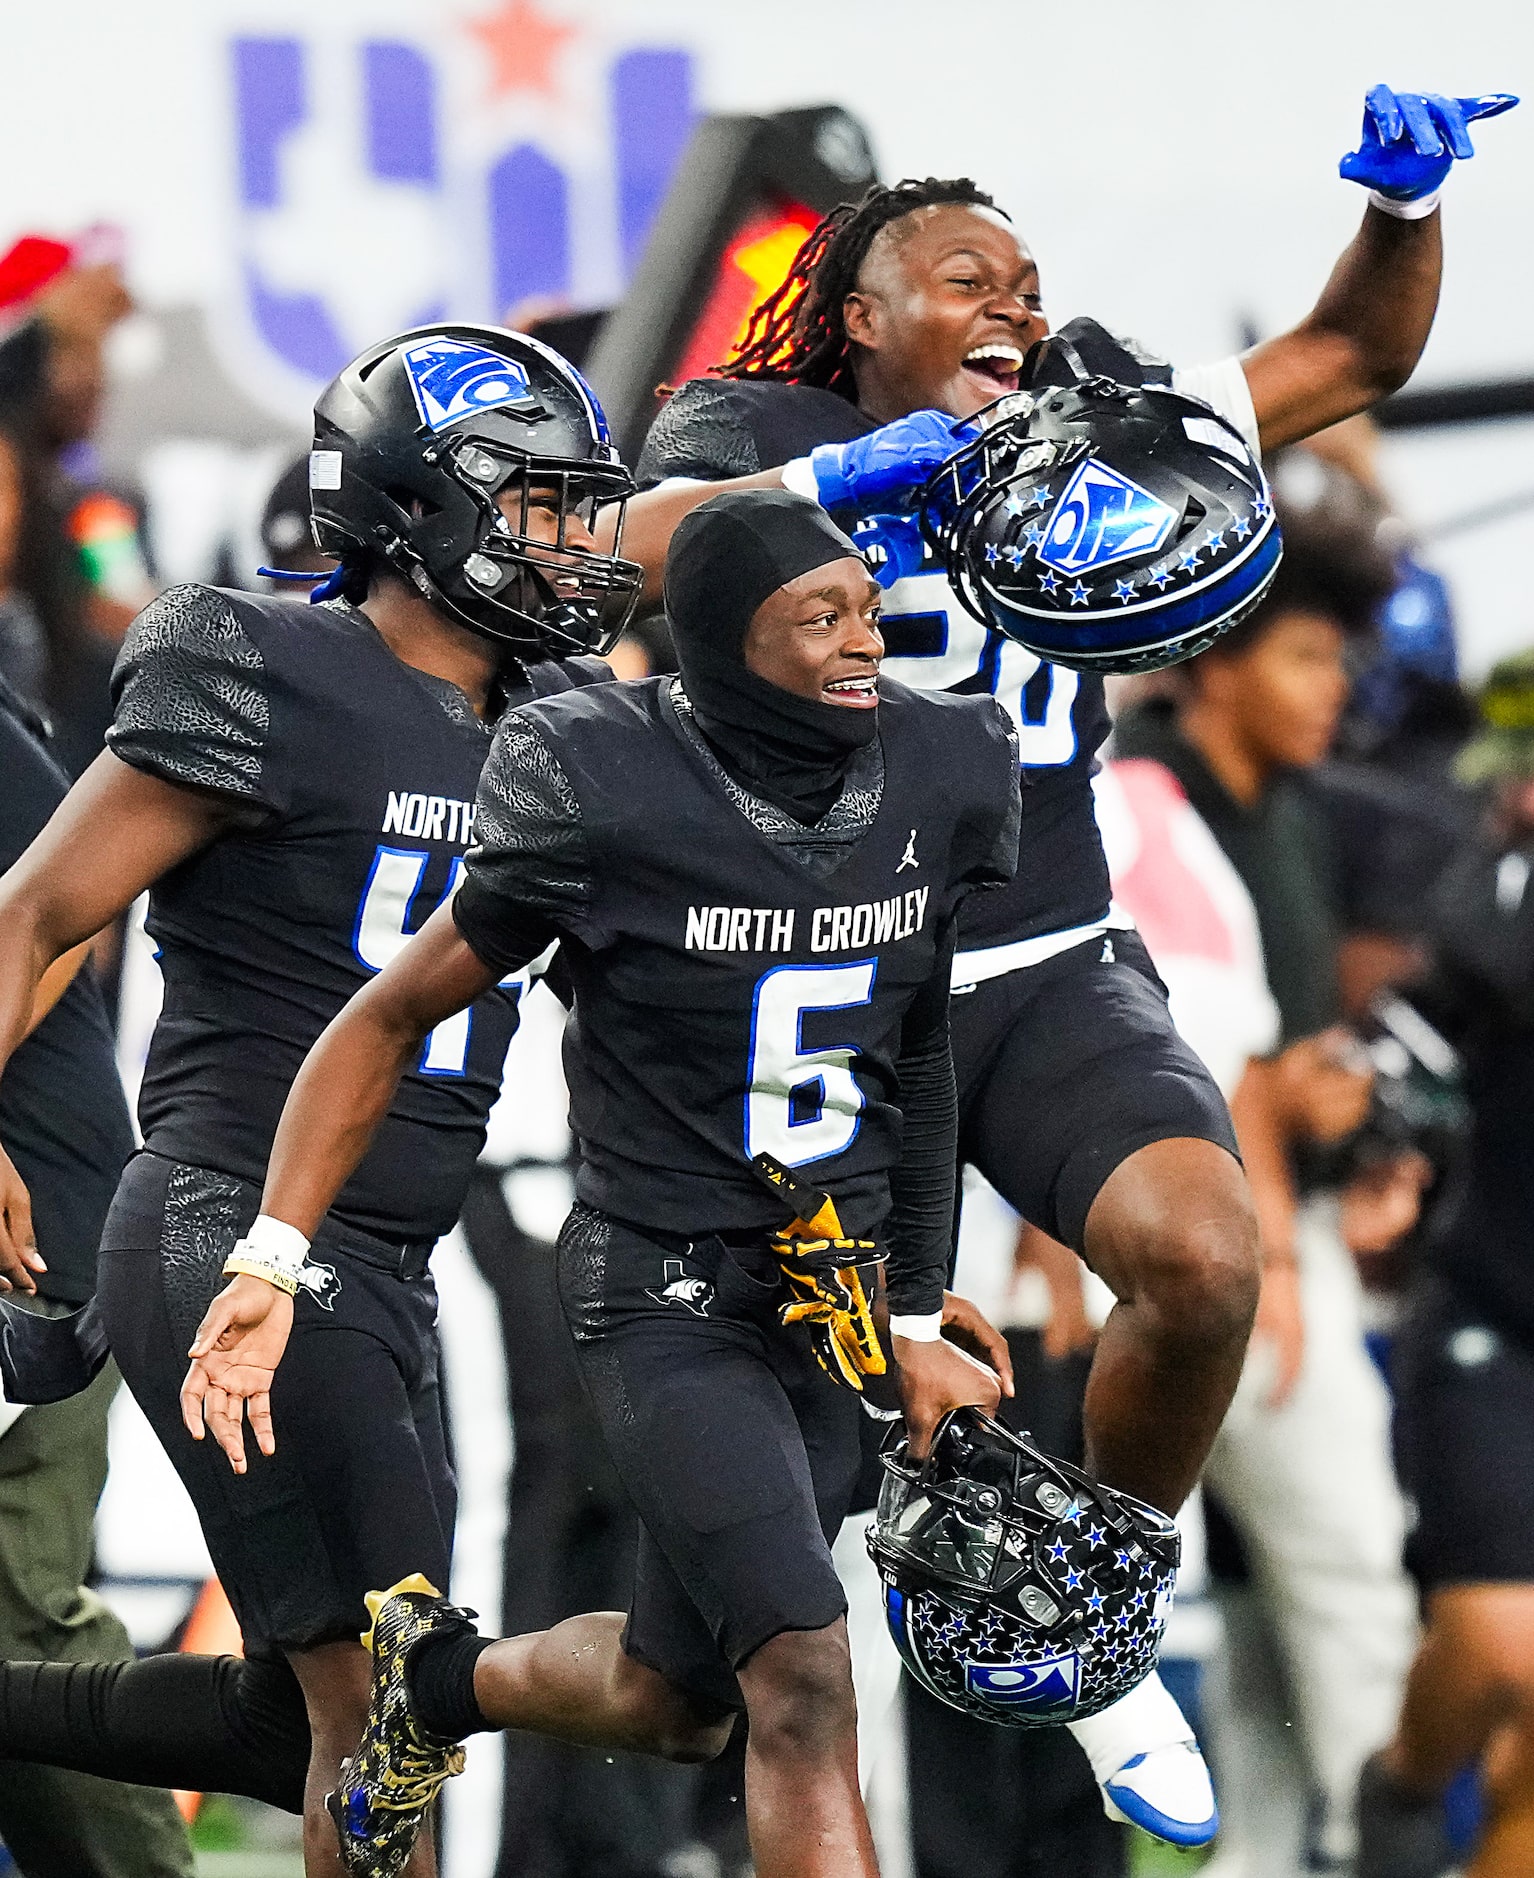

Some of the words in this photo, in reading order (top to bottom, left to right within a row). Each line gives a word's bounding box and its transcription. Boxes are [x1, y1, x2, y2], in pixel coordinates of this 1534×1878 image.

[382, 791, 477, 845] NORTH
[685, 906, 795, 952] NORTH
[810, 886, 929, 952] CROWLEY
[743, 956, 878, 1168] 6
